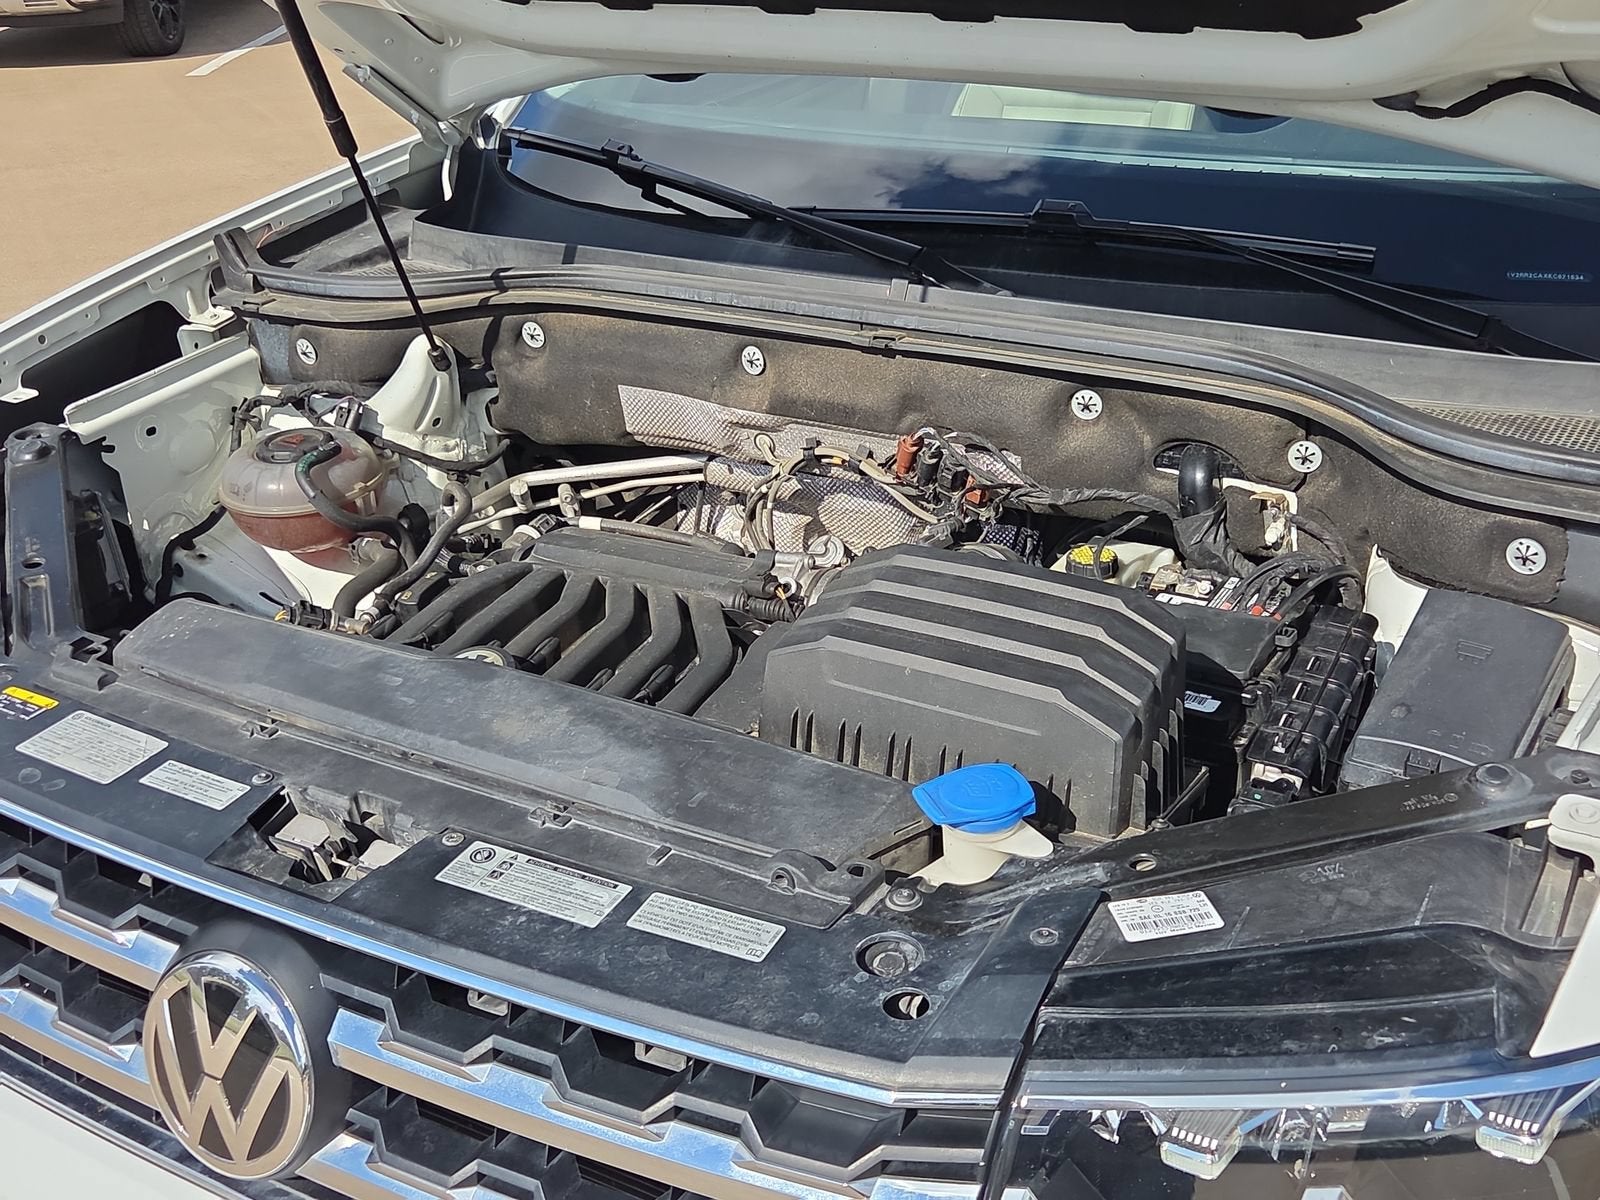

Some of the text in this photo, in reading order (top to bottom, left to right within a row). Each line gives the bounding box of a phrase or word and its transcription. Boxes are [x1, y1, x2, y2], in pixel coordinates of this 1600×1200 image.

[557, 867, 584, 878] WARNING
[585, 876, 616, 887] ATTENTION
[734, 916, 764, 926] PERMANENT
[144, 953, 312, 1177] VW
